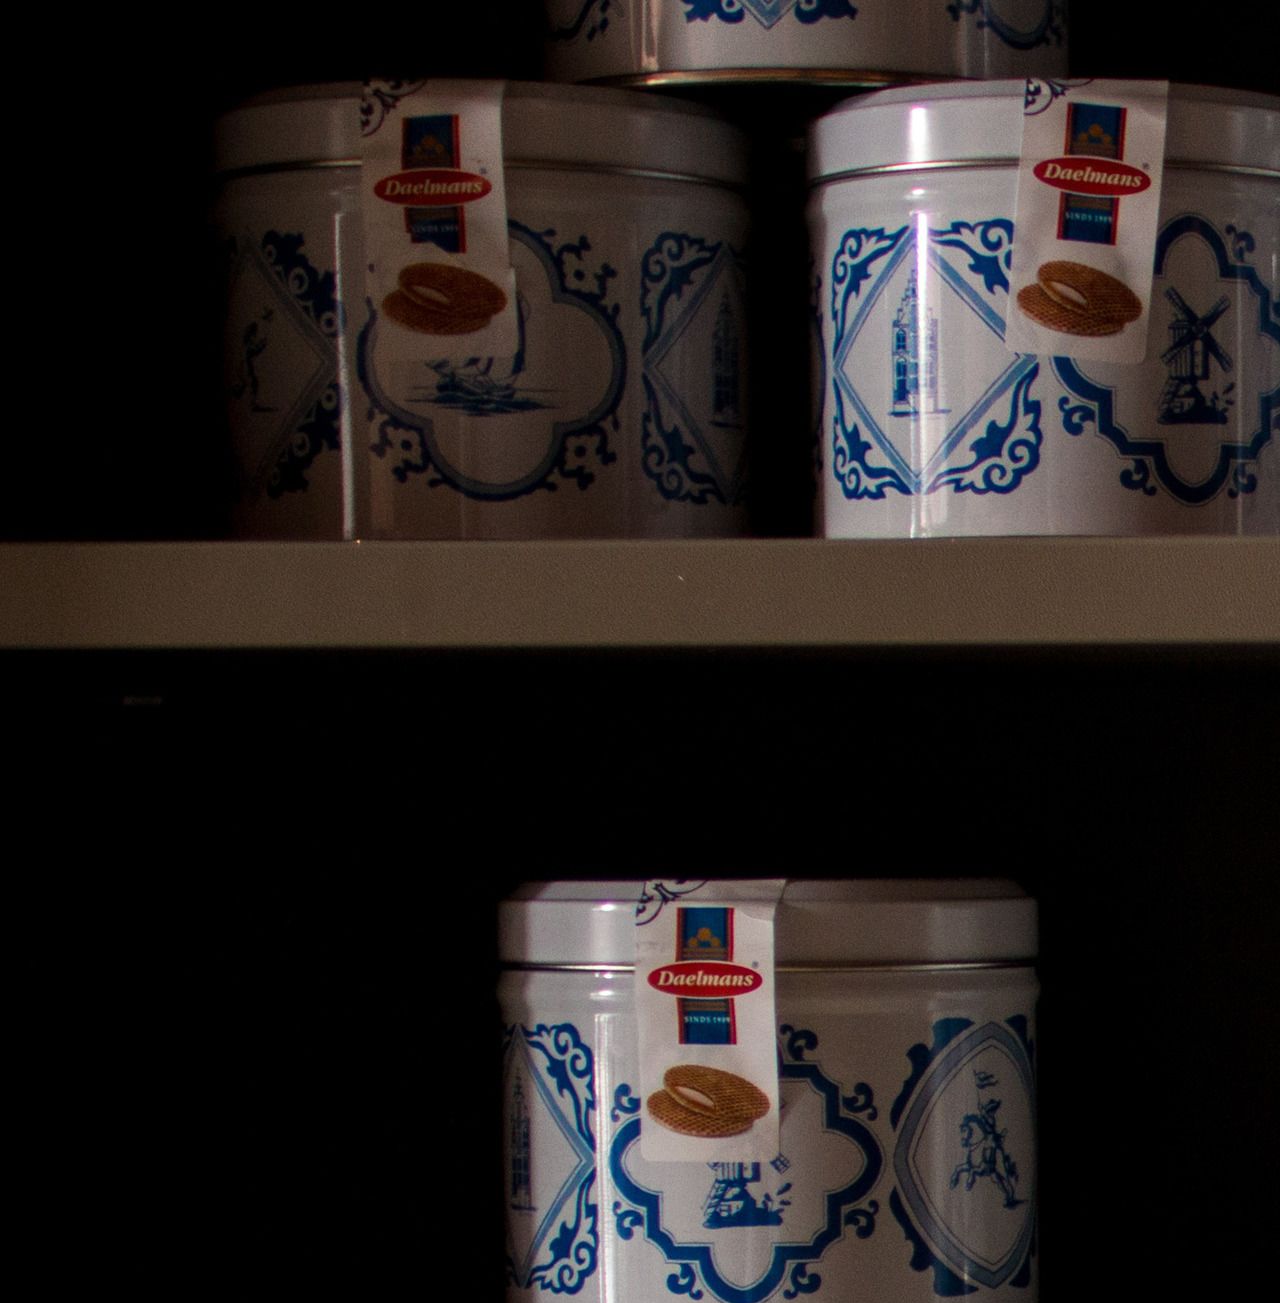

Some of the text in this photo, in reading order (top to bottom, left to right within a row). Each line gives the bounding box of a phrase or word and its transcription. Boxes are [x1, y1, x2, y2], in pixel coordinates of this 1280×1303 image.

[1044, 163, 1141, 187] Daelmans
[384, 178, 483, 195] Daelmans
[658, 971, 754, 987] Daelmans
